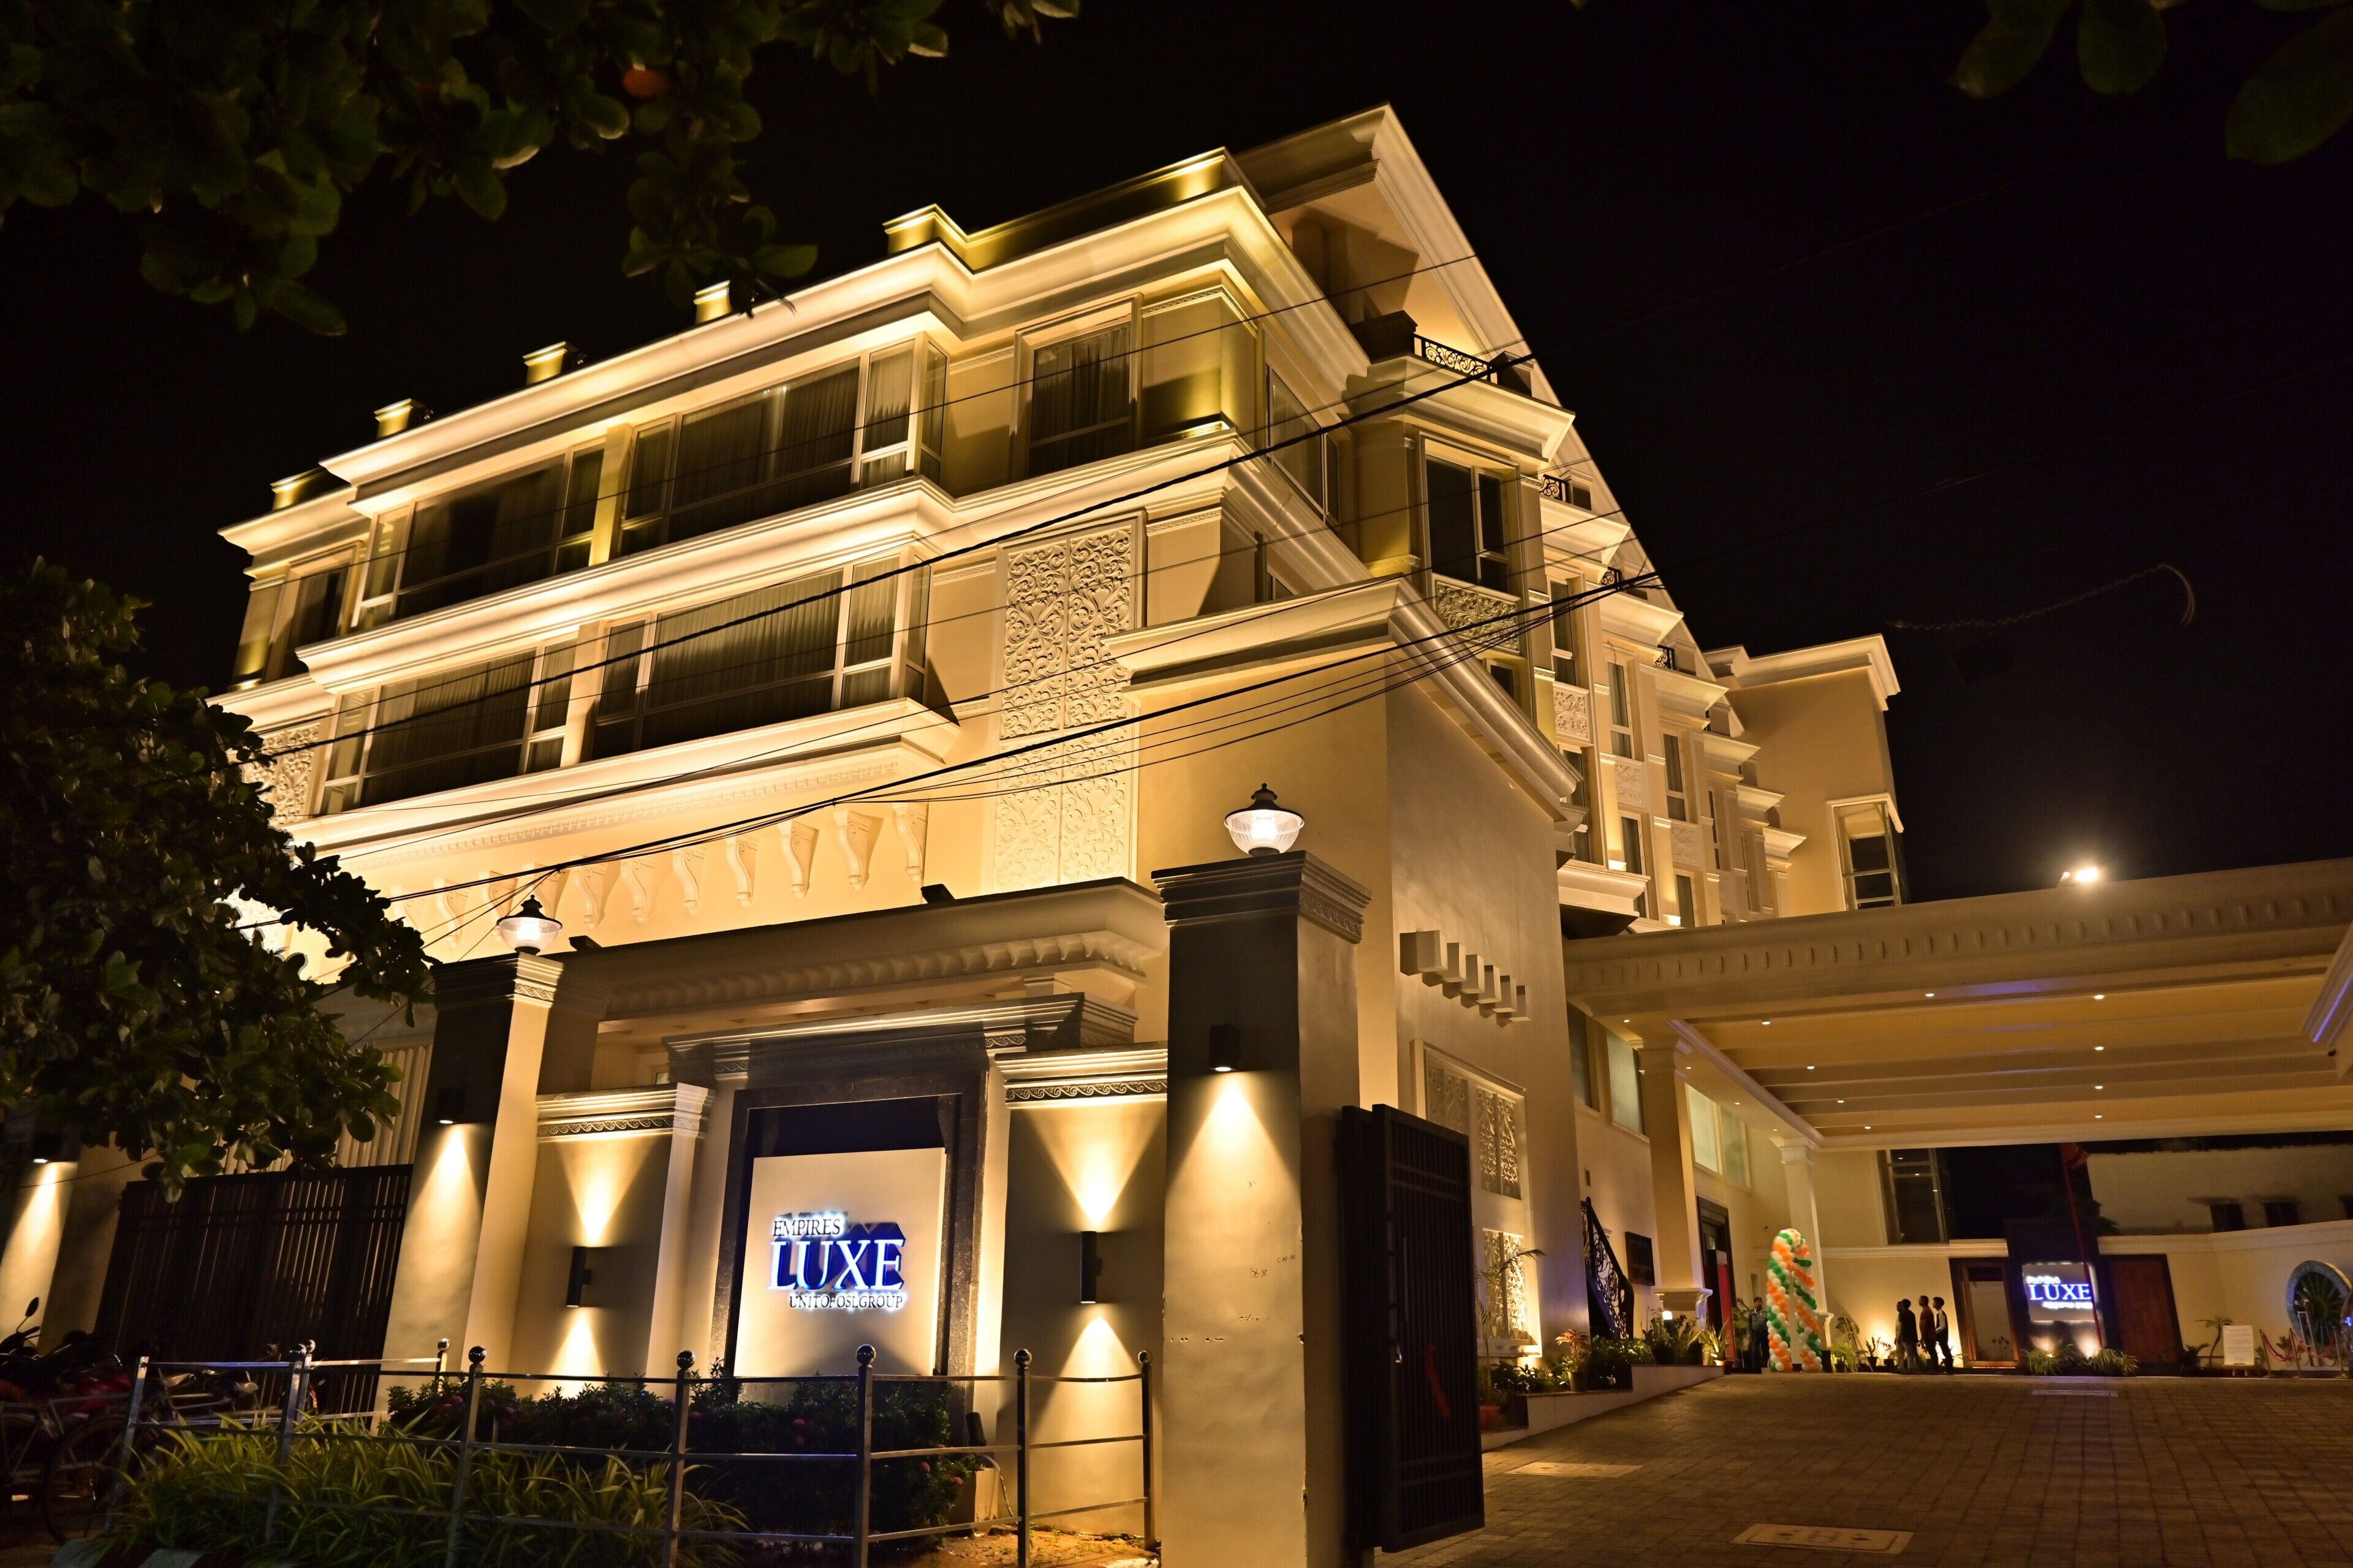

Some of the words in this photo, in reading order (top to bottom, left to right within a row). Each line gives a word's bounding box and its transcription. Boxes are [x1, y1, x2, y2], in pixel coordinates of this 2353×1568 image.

[772, 1218, 841, 1238] EMPIRES
[766, 1238, 906, 1290] LUXE
[2028, 1284, 2092, 1300] LUXE
